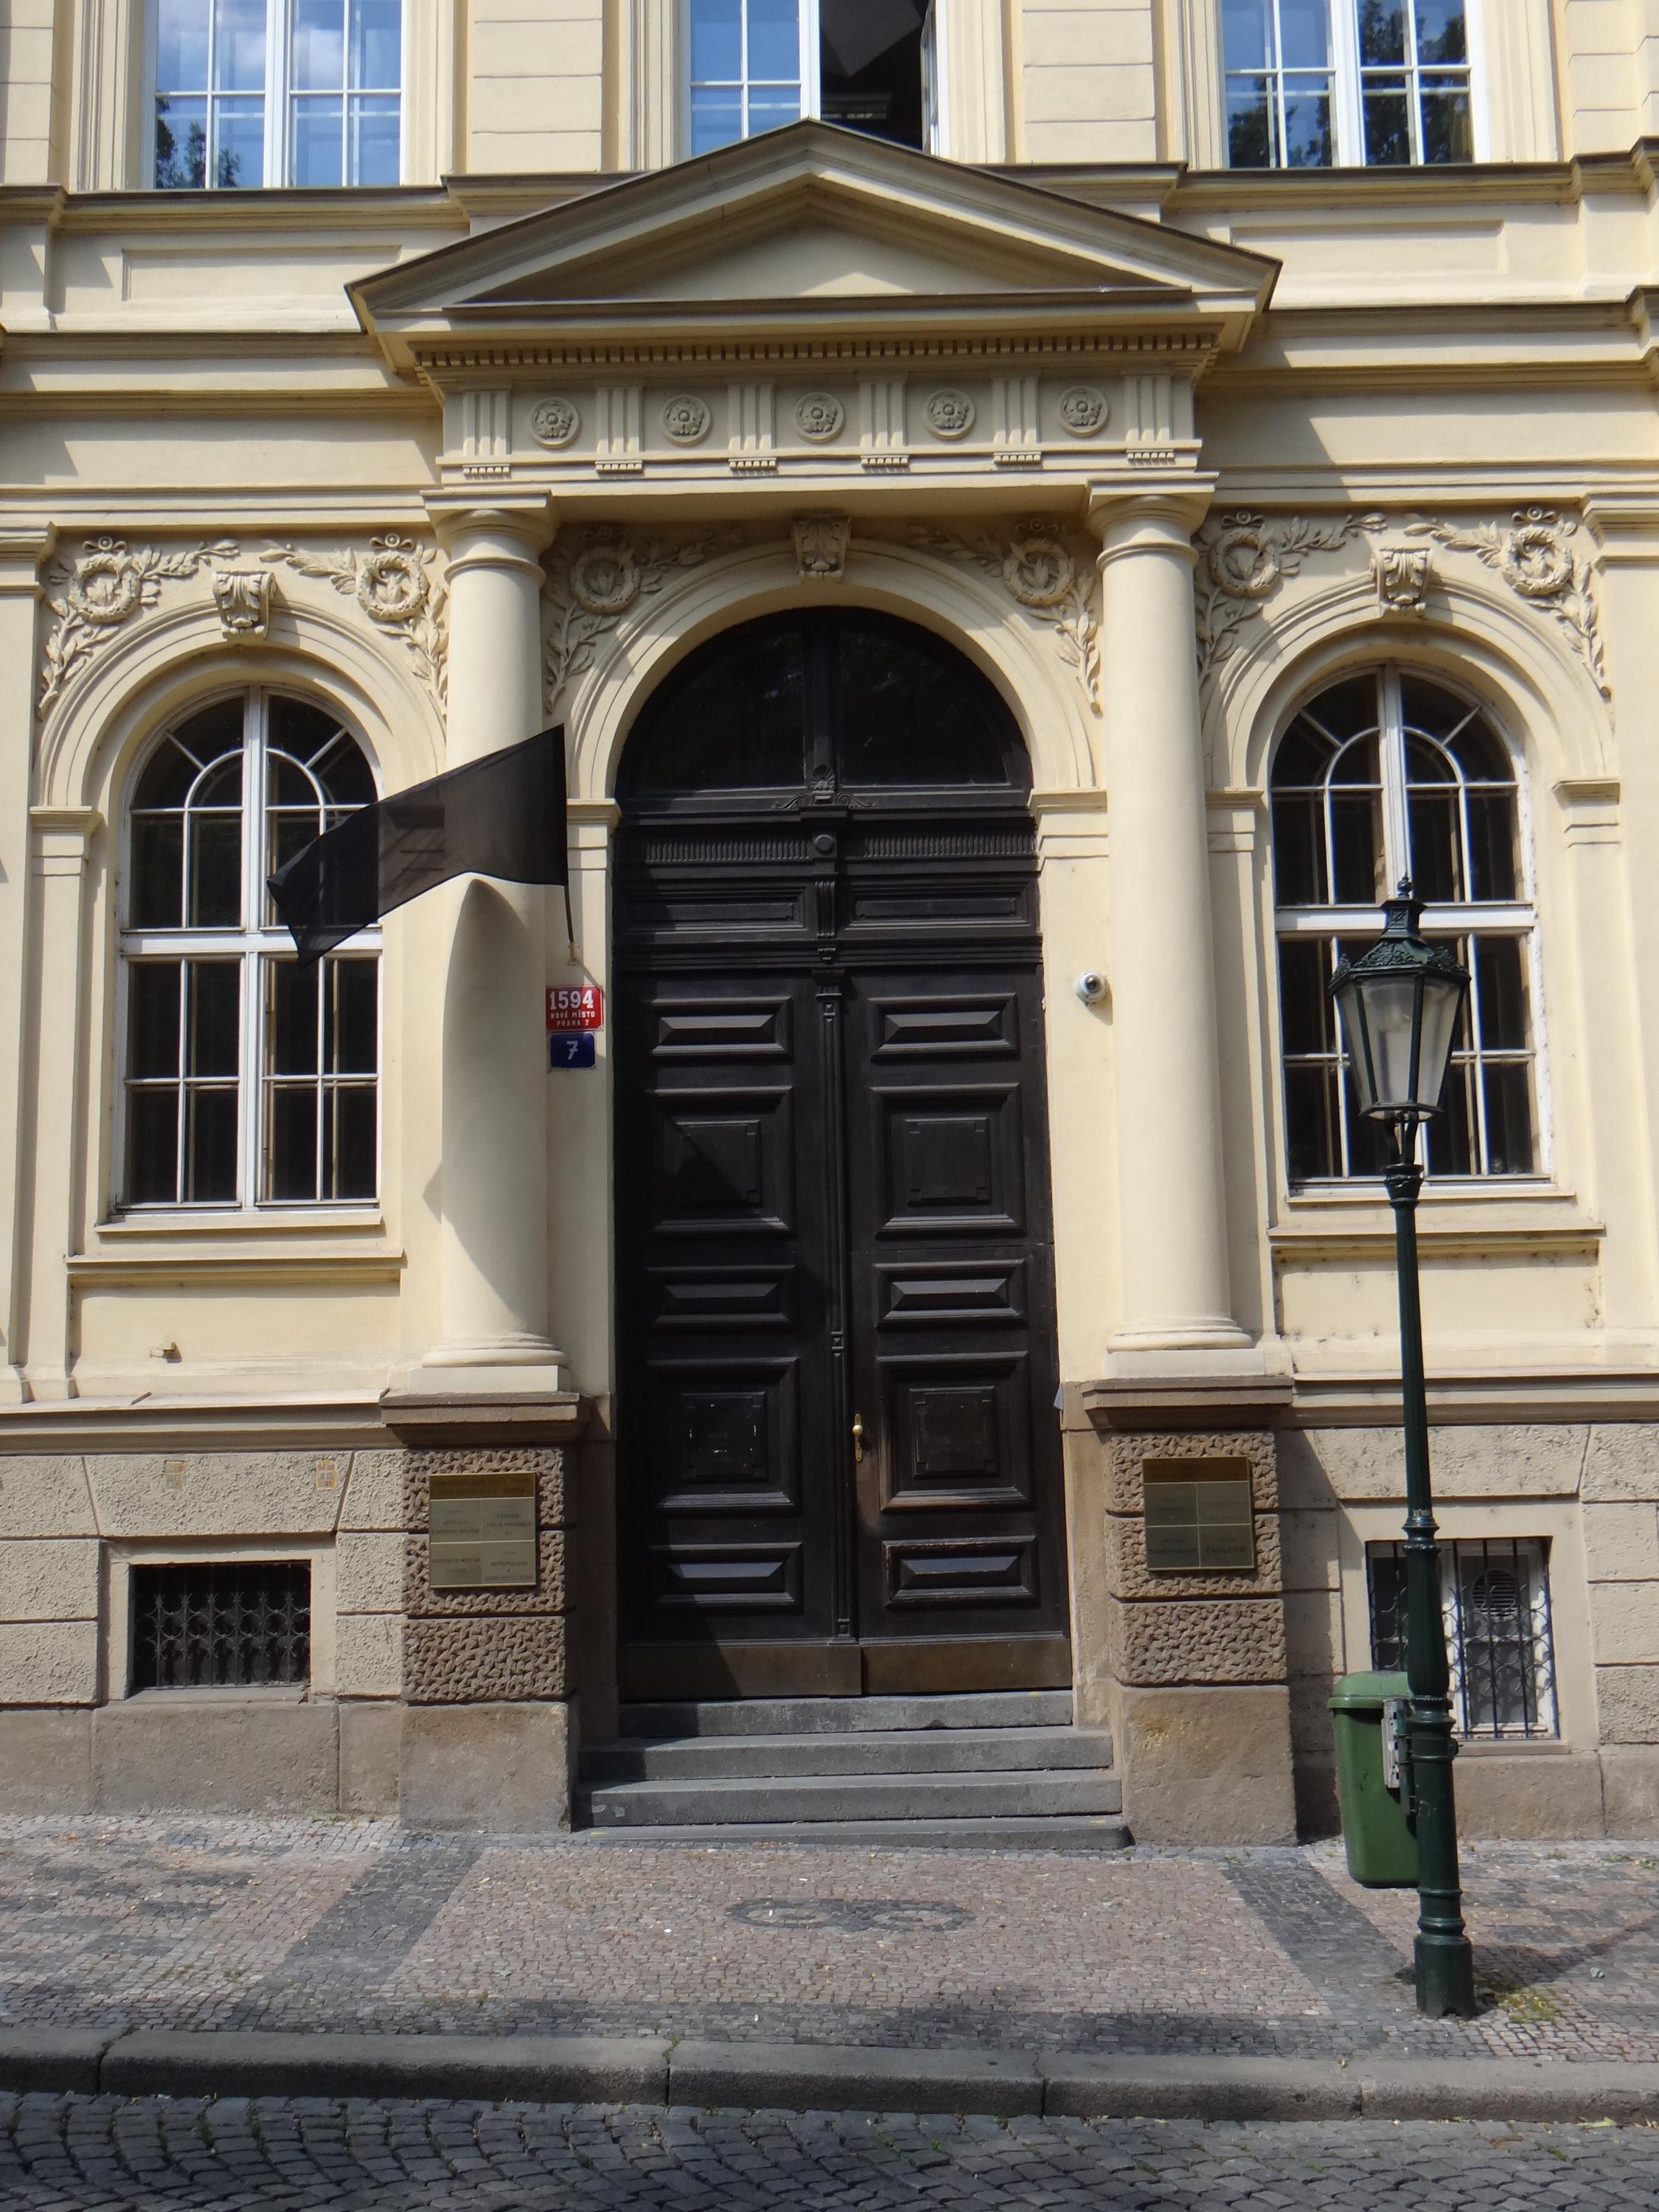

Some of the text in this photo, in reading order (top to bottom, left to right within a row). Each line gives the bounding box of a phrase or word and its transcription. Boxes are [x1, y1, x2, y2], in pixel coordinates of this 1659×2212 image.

[550, 990, 594, 1009] 1594
[551, 1010, 568, 1019] NOVÉ
[566, 1040, 579, 1060] 7
